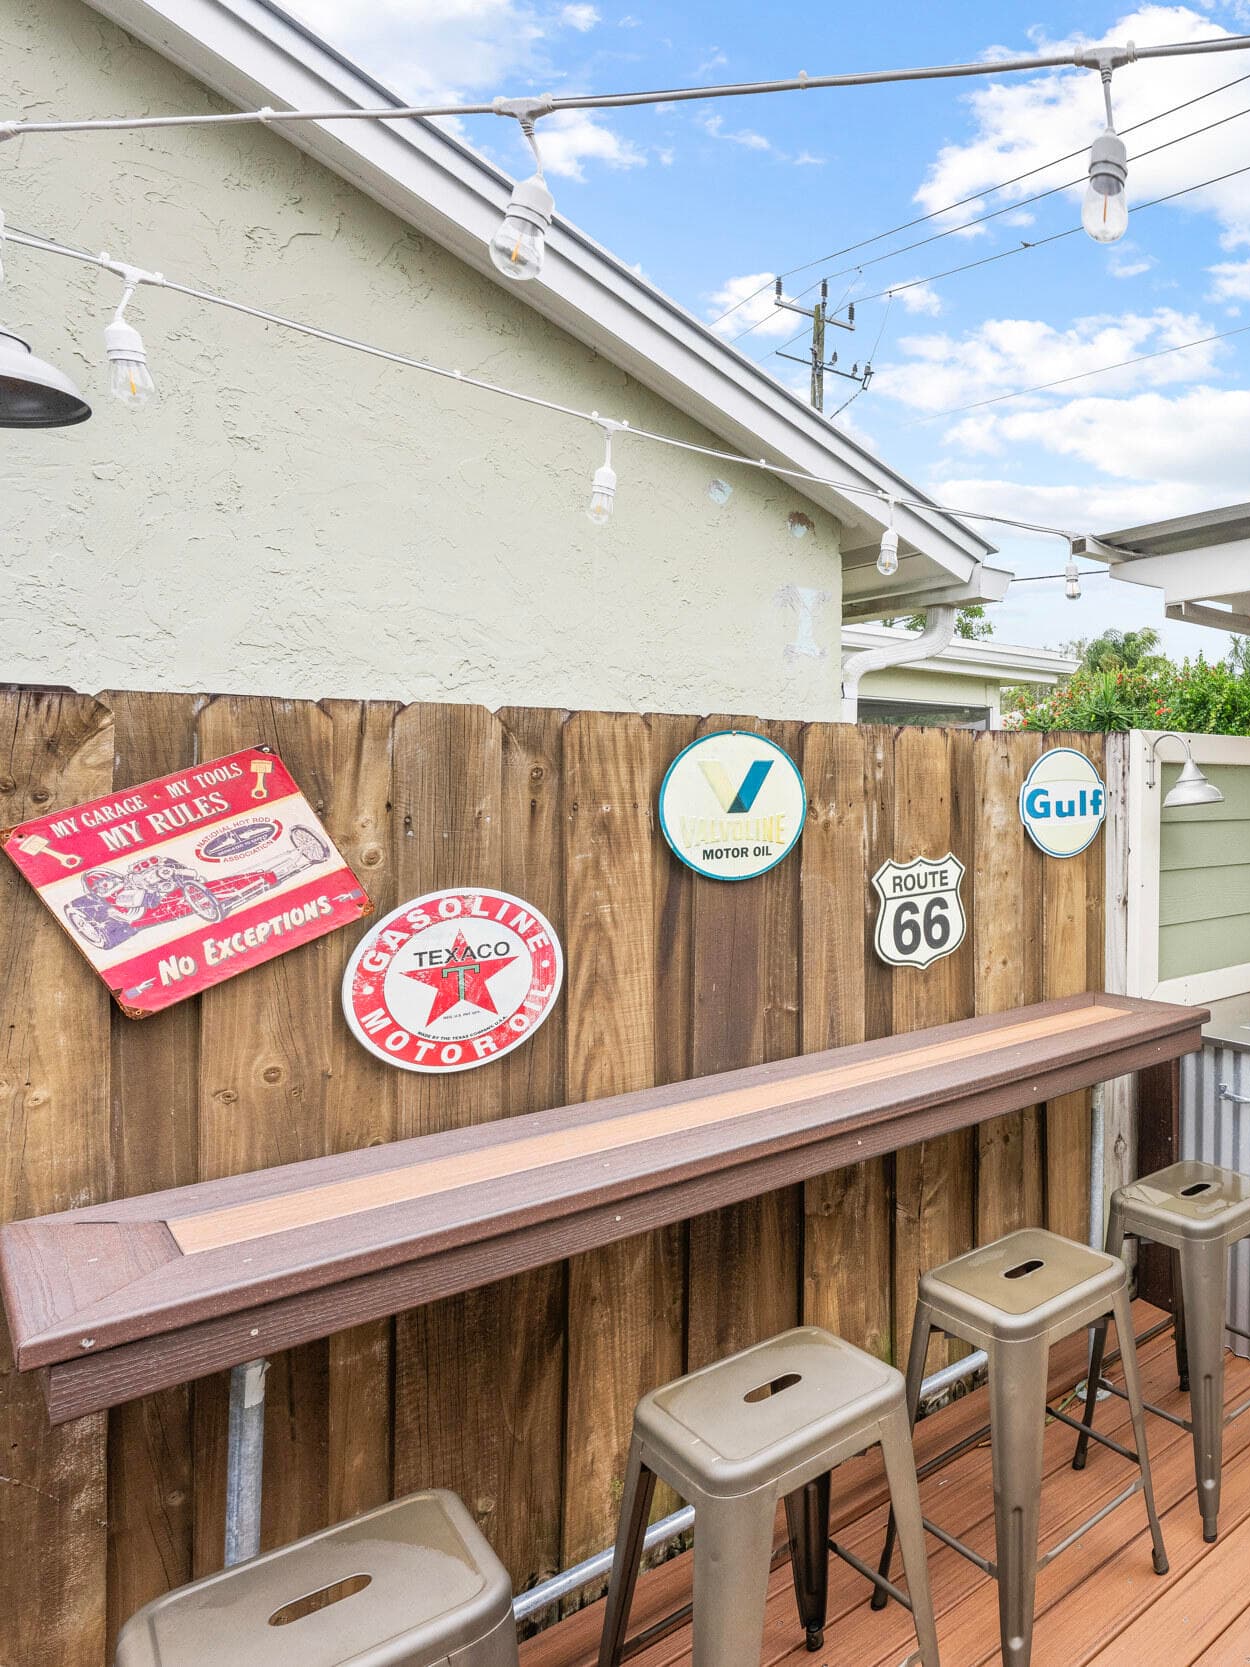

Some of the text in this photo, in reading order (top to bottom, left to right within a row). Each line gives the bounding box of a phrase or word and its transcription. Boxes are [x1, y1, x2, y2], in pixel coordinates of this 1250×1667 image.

[49, 762, 243, 839] MY GARAGE MY TOOLS
[1025, 788, 1103, 820] Gulf
[98, 791, 231, 852] MY RULES
[196, 825, 232, 849] NATIONAL
[233, 819, 250, 828] HOT
[223, 840, 274, 863] ASSOCIATION
[702, 845, 772, 860] MOTOR OIL
[892, 870, 949, 893] ROUTE
[362, 897, 551, 973] GASOLINE
[893, 897, 950, 955] 66
[413, 941, 510, 968] TEXACO
[361, 983, 553, 1064] MOTOR OIL
